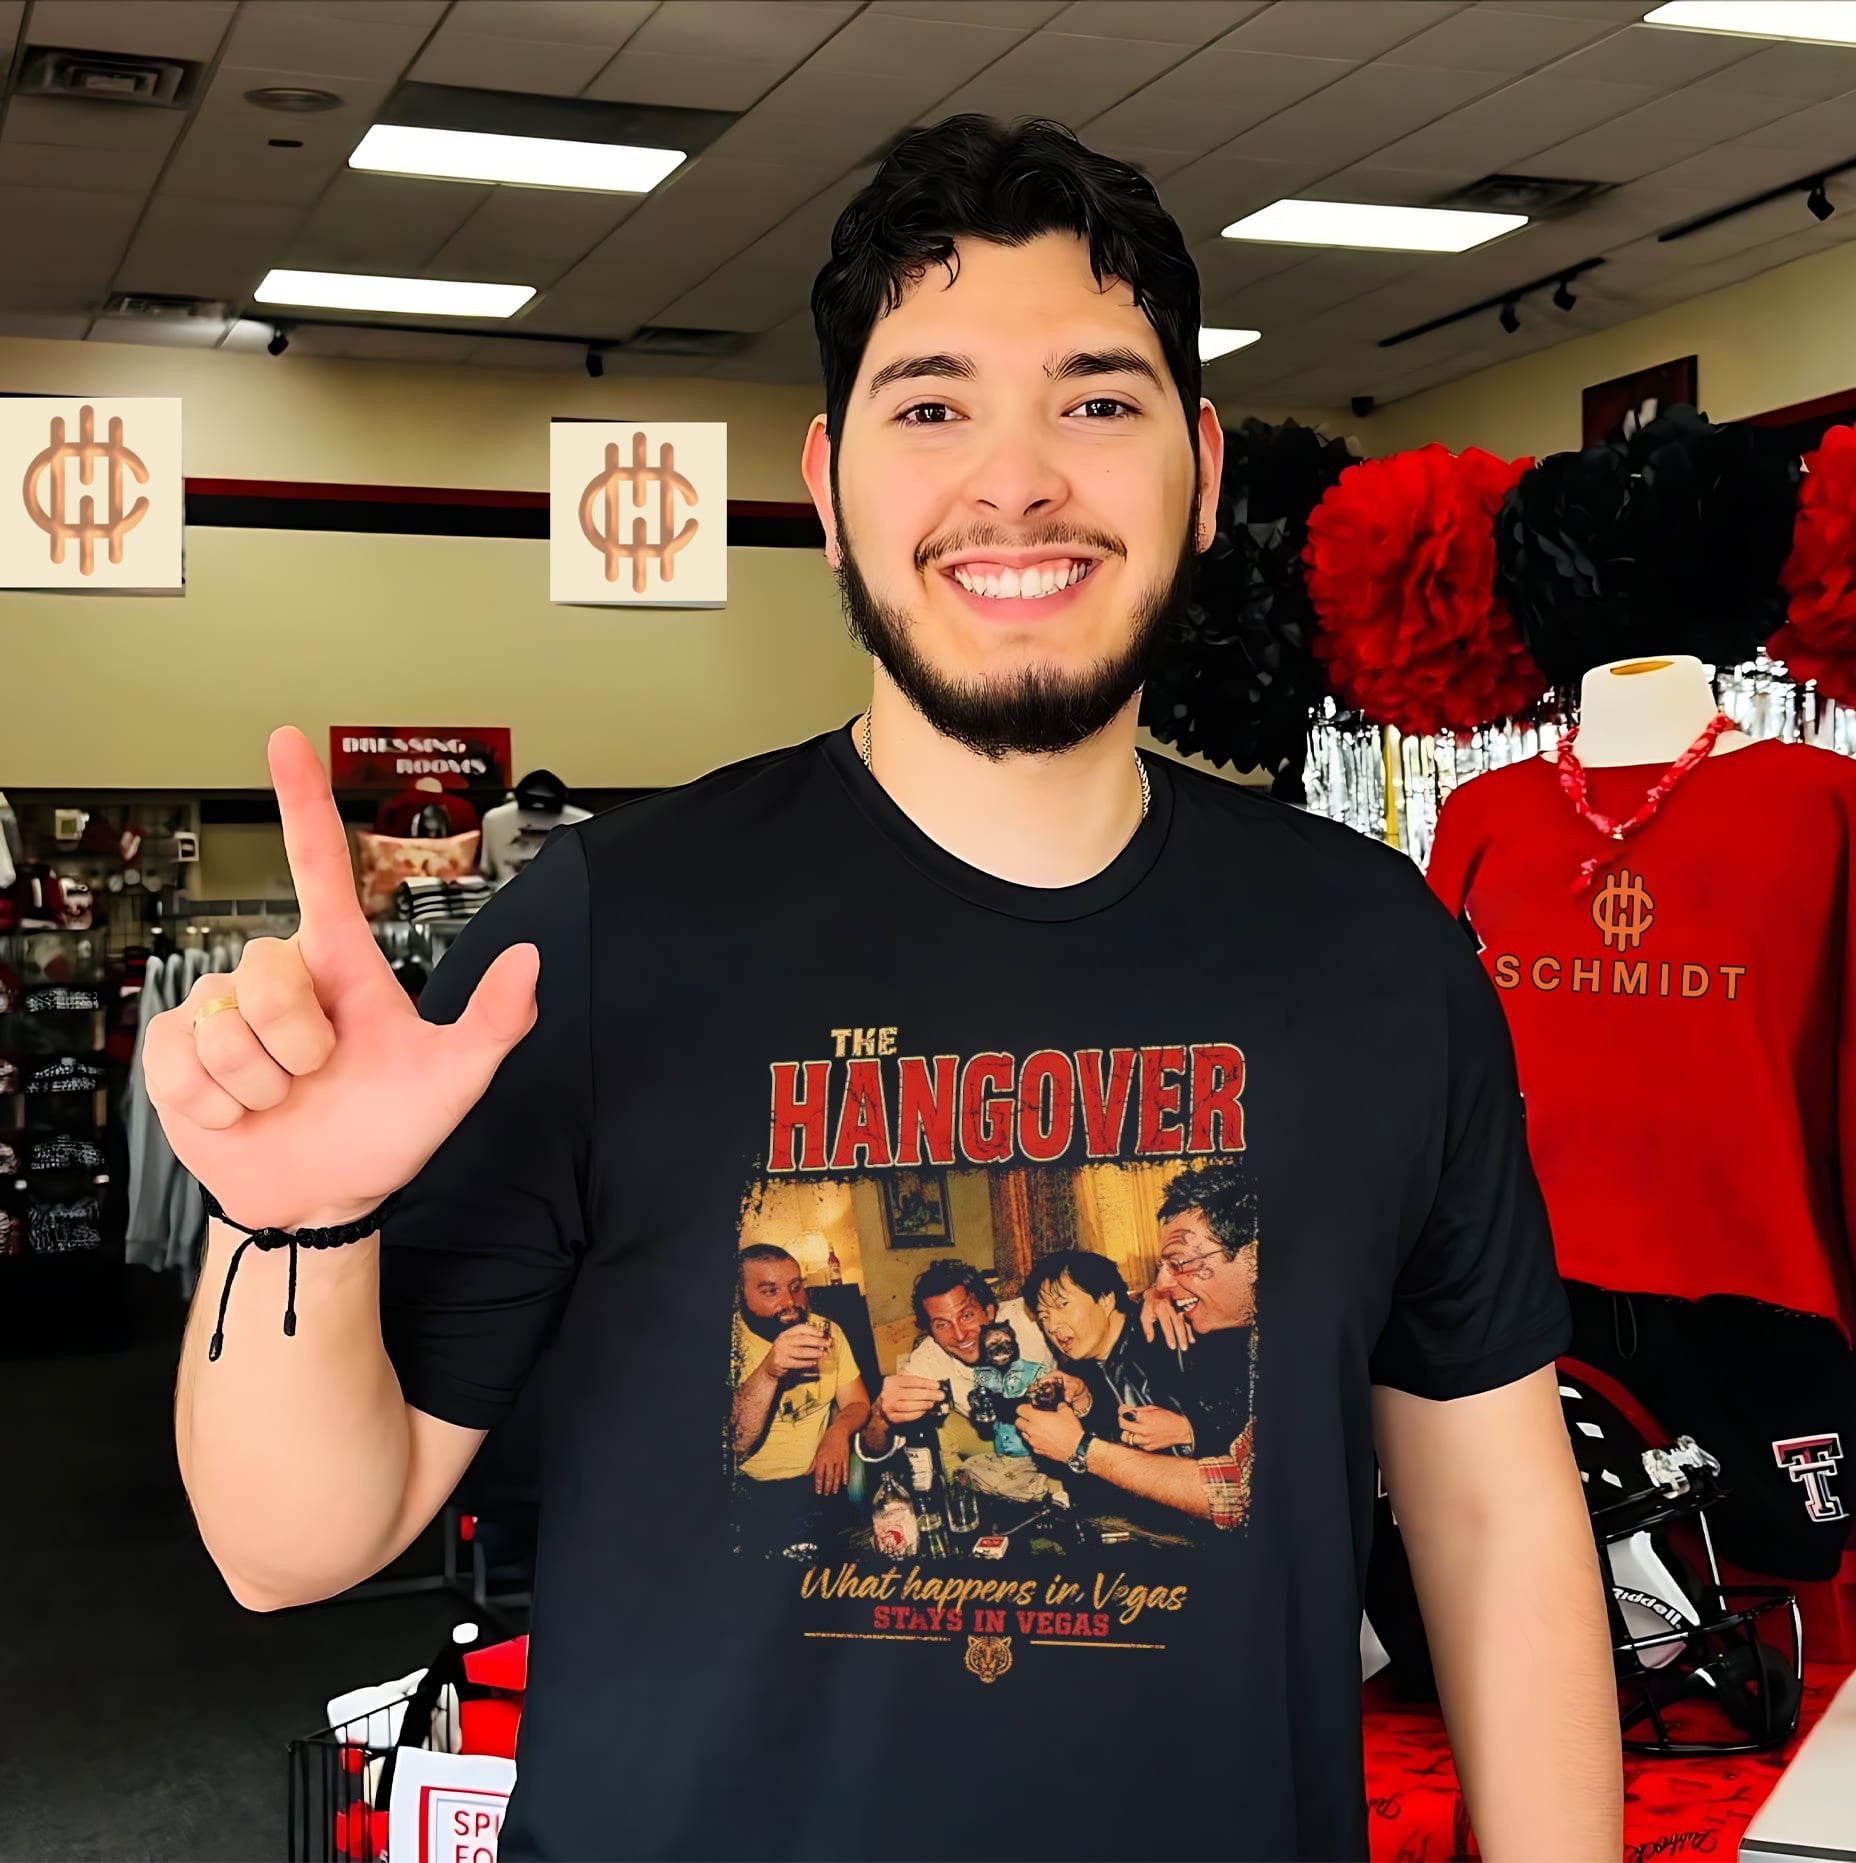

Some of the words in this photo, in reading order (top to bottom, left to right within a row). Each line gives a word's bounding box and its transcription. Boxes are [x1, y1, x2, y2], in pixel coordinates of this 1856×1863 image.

[396, 758, 487, 775] ROOMS
[1494, 953, 1746, 1000] SCHMIDT
[830, 1026, 898, 1057] THE
[767, 1043, 1247, 1173] HANGOVER
[801, 1562, 901, 1600] What
[903, 1565, 1036, 1615] happens
[1045, 1573, 1085, 1604] in
[1092, 1571, 1188, 1625] Vegas
[873, 1605, 963, 1632] STAYS
[973, 1609, 1005, 1634] IN
[1016, 1610, 1111, 1638] VEGAS
